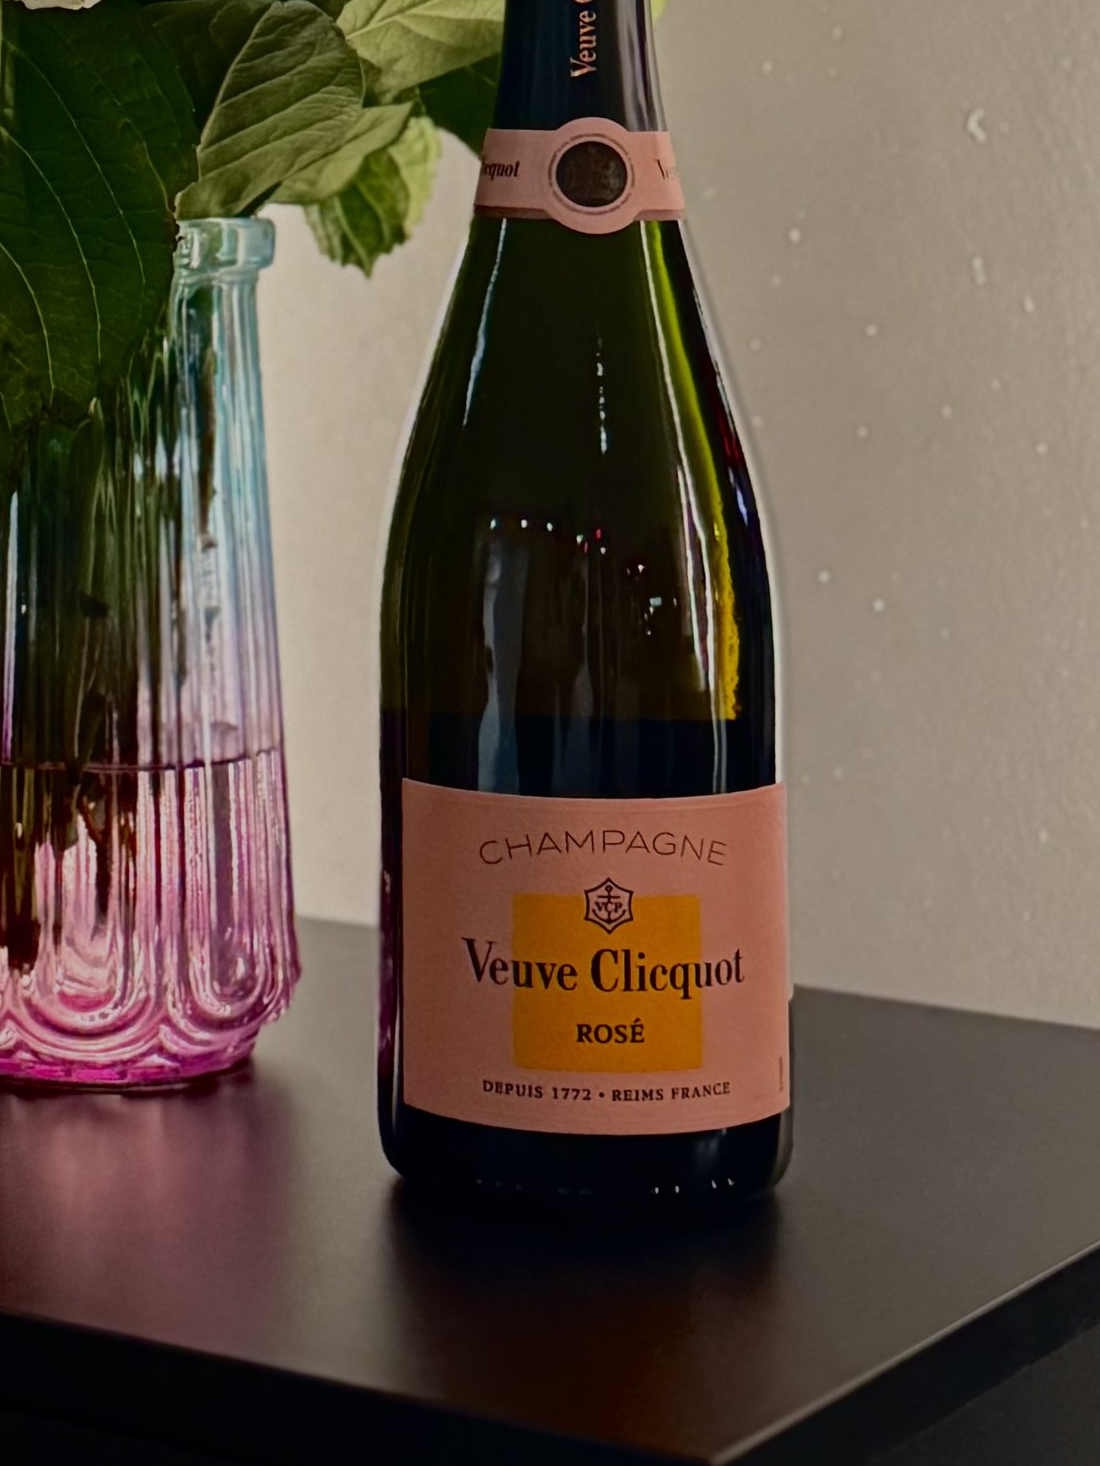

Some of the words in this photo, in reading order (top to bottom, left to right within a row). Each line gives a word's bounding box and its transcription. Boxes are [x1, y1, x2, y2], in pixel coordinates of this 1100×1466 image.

[570, 9, 597, 78] Veuve
[478, 829, 727, 867] CHAMPAGNE
[594, 900, 624, 914] VCP
[460, 936, 578, 991] Veuve
[590, 948, 745, 1001] Clicquot
[575, 1018, 646, 1045] ROSÉ
[482, 1079, 544, 1099] DEPUIS
[551, 1086, 592, 1102] 1772
[611, 1087, 665, 1102] REIMS
[670, 1081, 732, 1100] FRANCE
